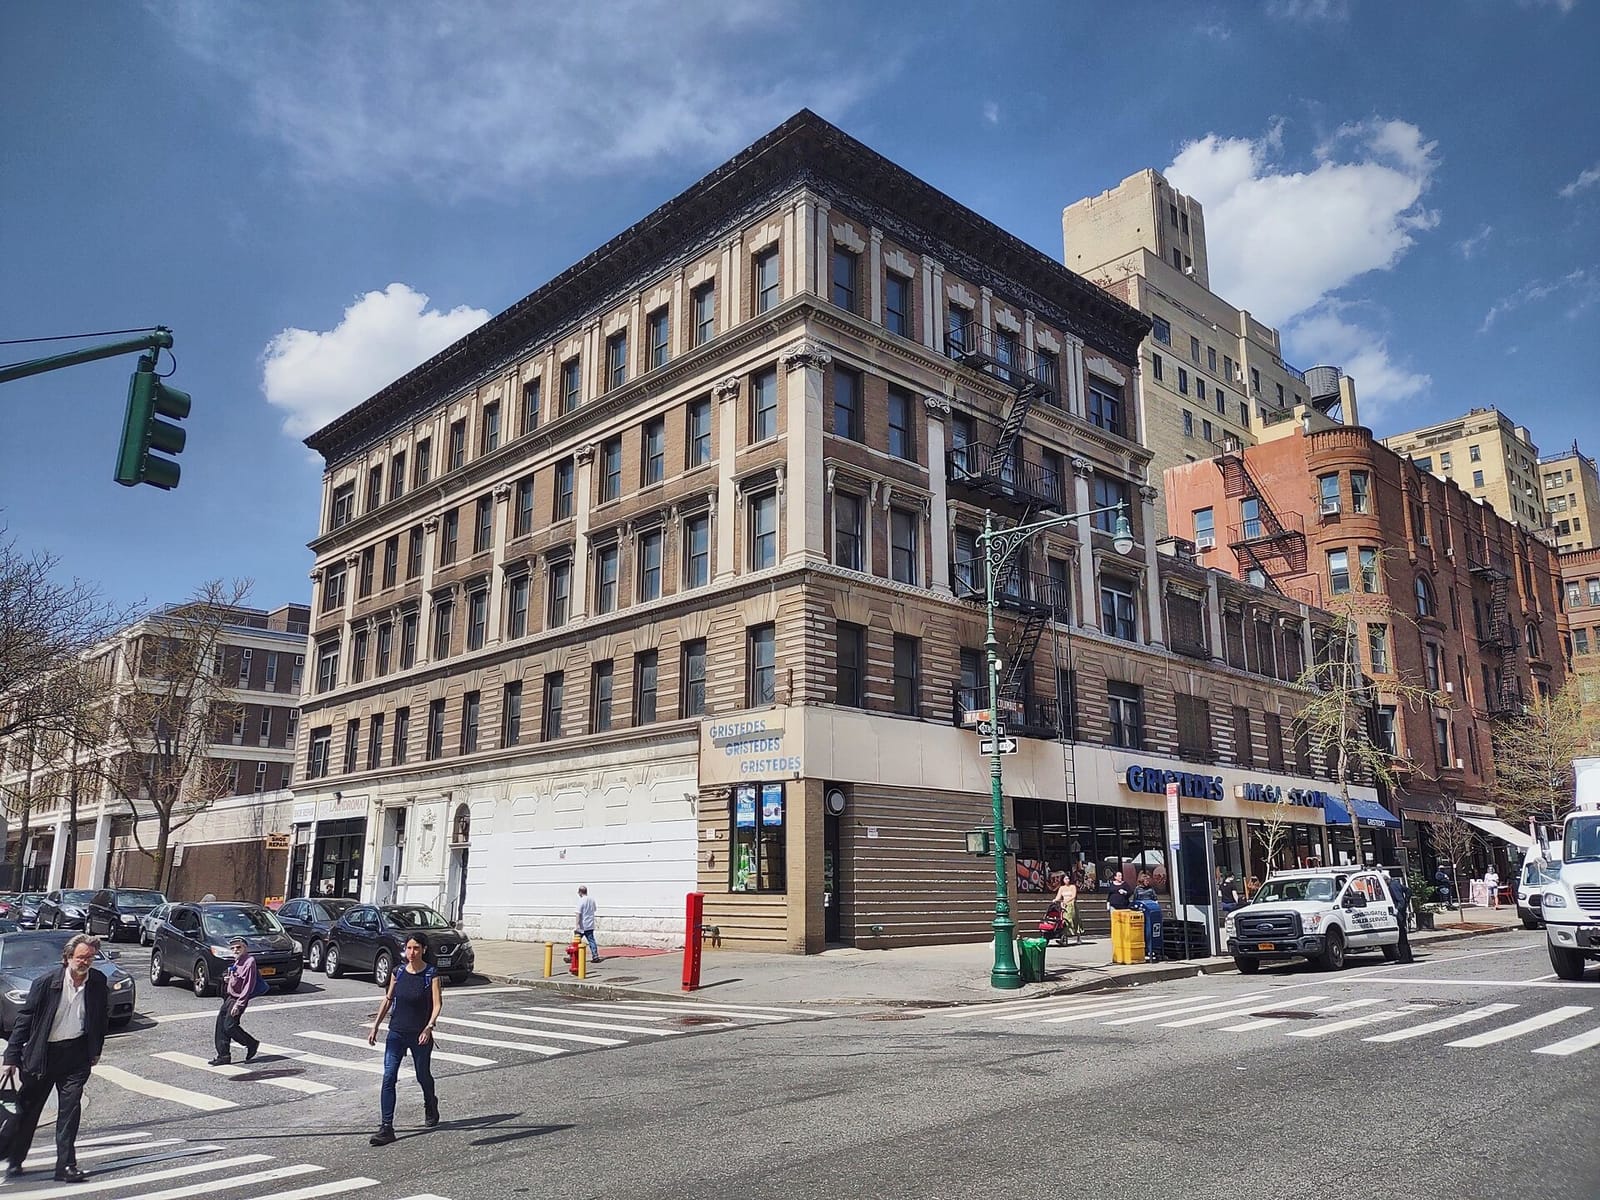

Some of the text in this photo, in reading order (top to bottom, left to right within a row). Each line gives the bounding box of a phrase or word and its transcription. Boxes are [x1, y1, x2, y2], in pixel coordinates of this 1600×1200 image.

[709, 720, 766, 738] GRISTEDES
[725, 737, 780, 755] GRISTEDES
[741, 757, 801, 773] GRISTEDES
[1126, 765, 1224, 801] GRISTEDES
[1243, 783, 1283, 804] MEGA
